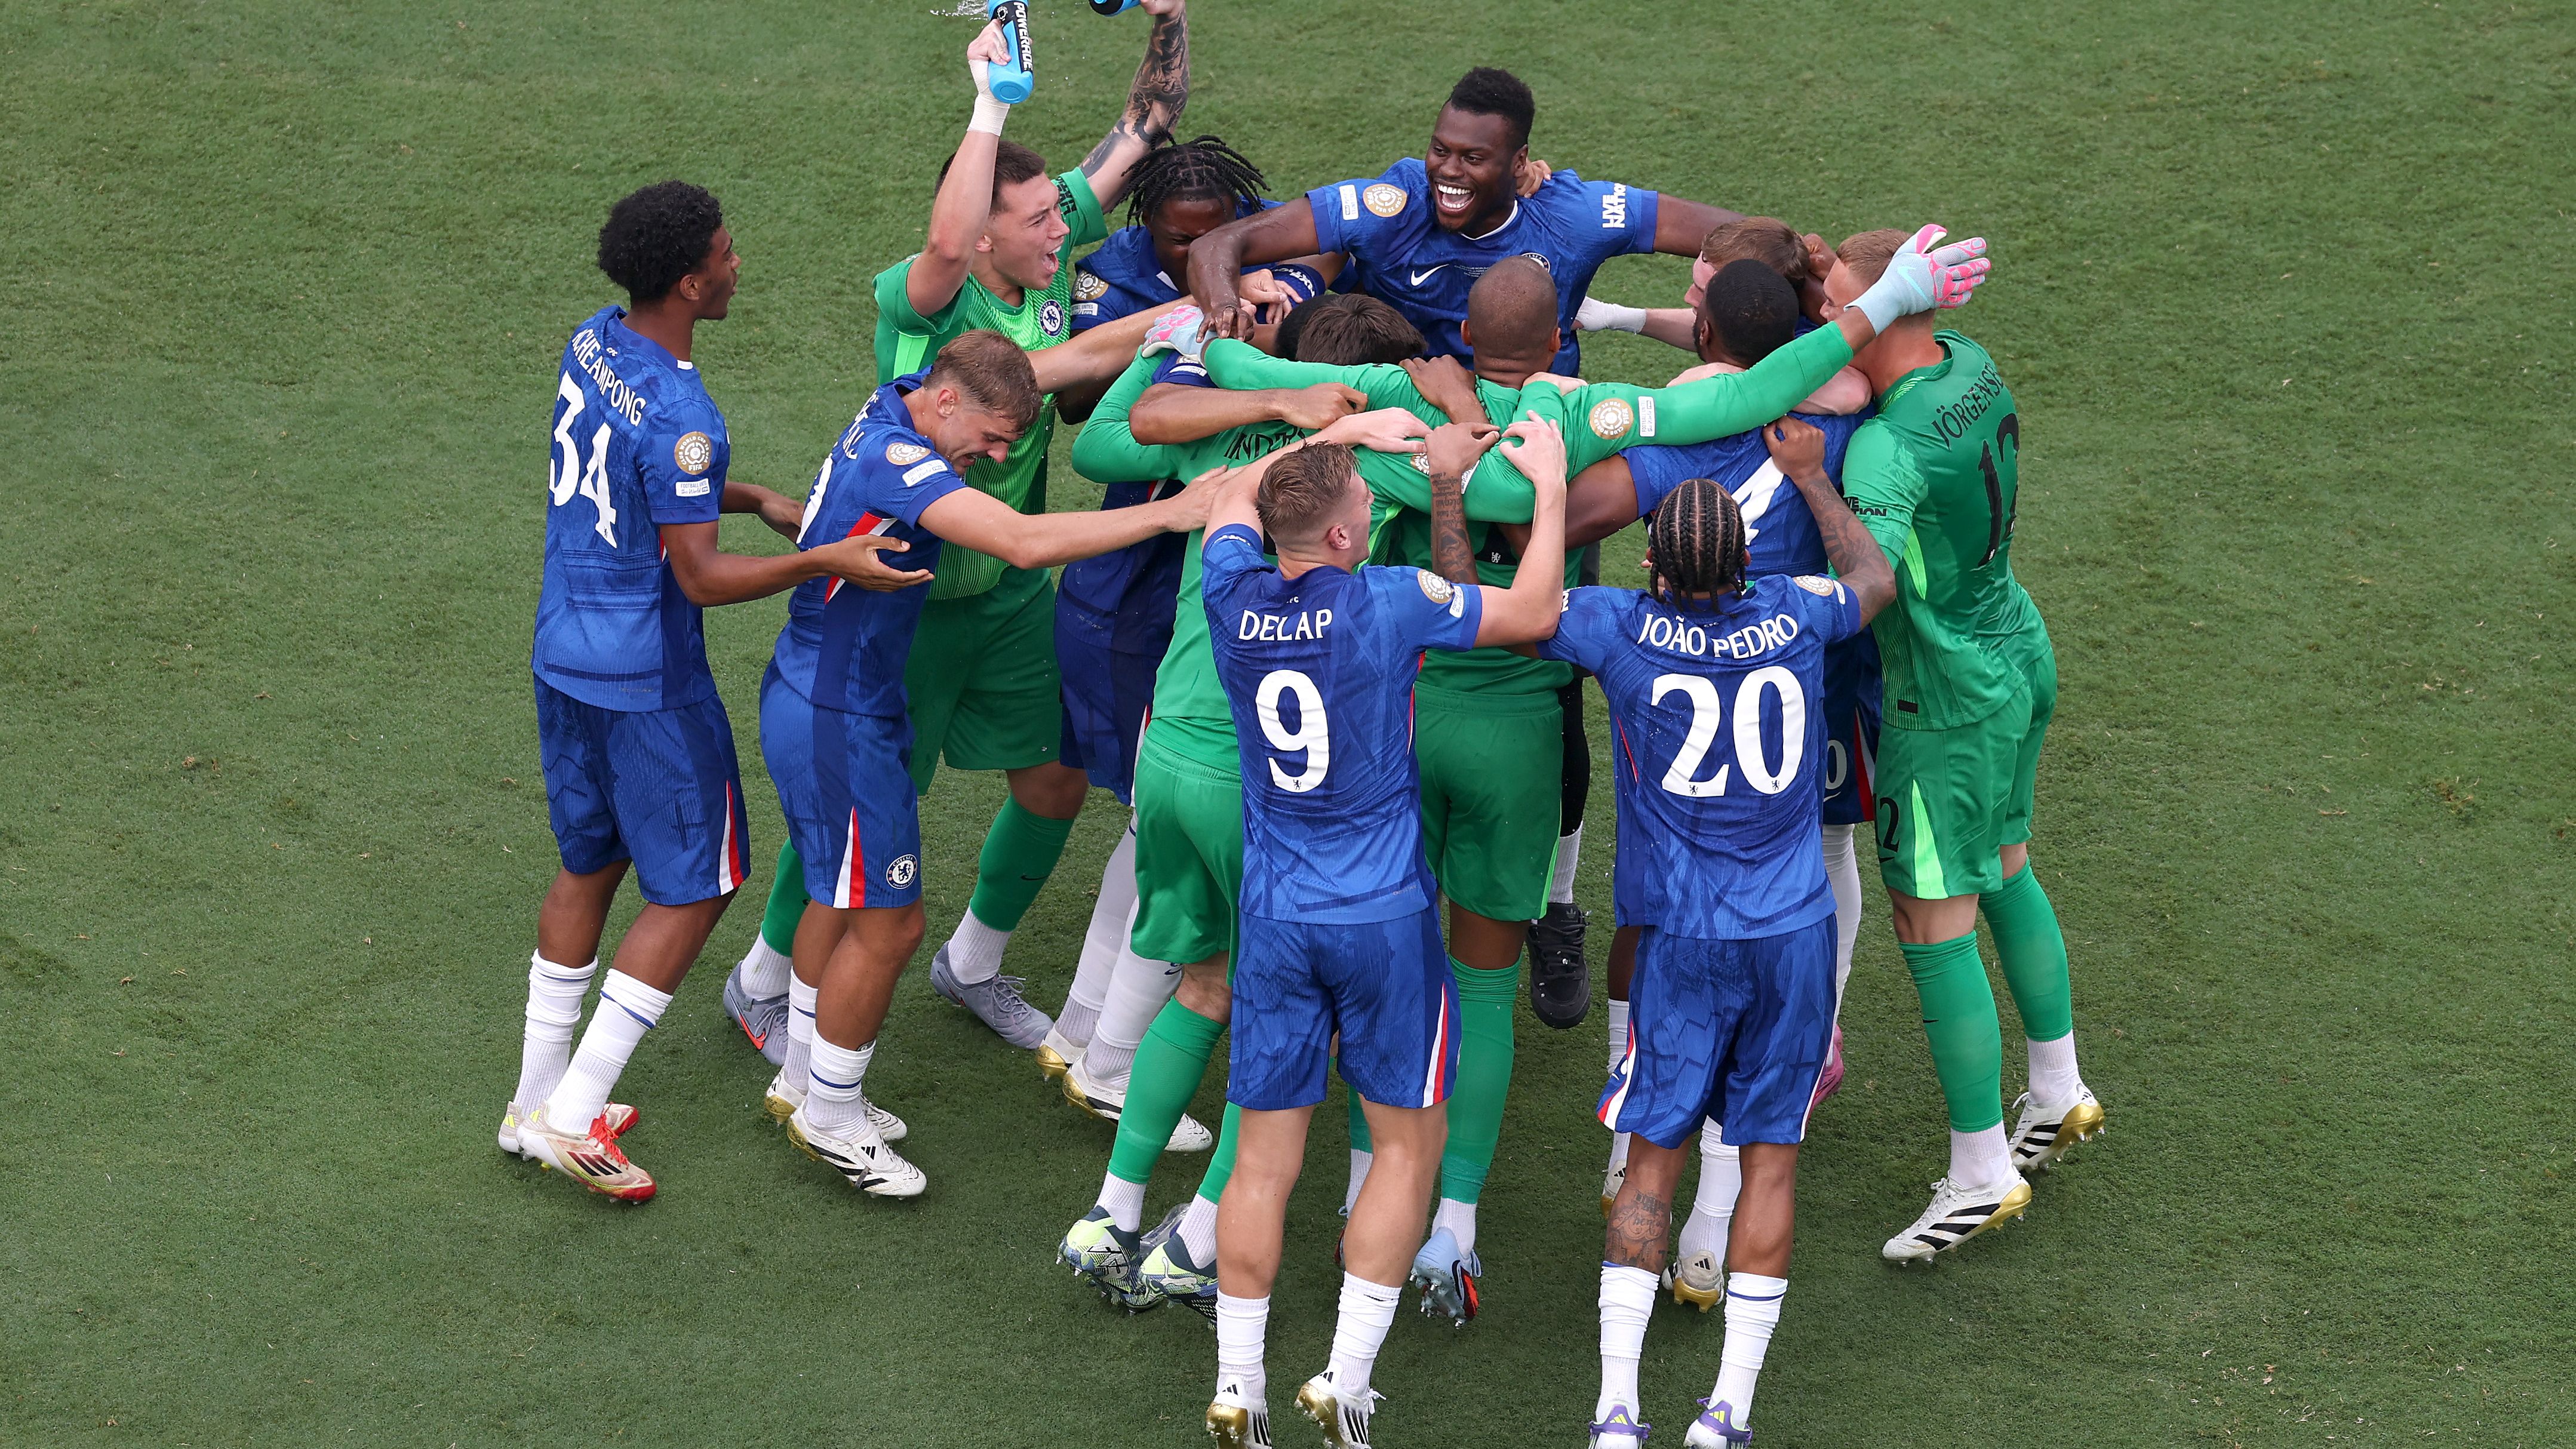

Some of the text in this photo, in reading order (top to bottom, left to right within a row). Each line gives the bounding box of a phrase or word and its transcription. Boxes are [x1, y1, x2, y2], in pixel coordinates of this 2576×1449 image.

[1013, 2, 1033, 70] POWERADE
[1602, 195, 1614, 228] LIVE
[571, 328, 646, 427] ACHEAMPONG
[1931, 361, 2004, 452] JÖRGENSE
[549, 370, 617, 549] 34
[678, 451, 687, 465] CLUB
[680, 436, 696, 450] WORLD
[1238, 608, 1333, 641] DELAP
[1637, 613, 1798, 659] JOÃO PEDRO
[1255, 669, 1330, 793] 9
[1650, 665, 1806, 797] 20
